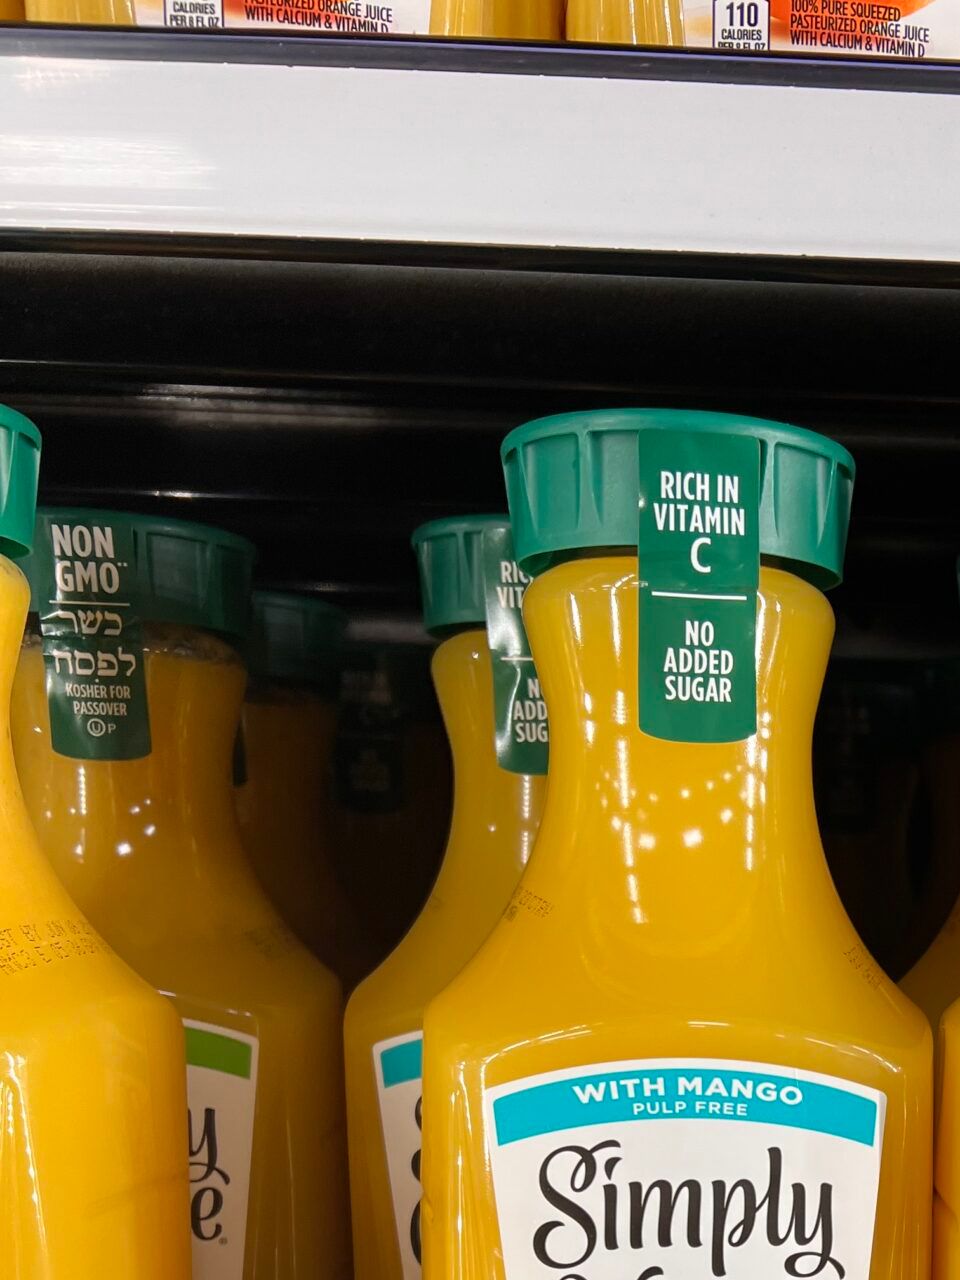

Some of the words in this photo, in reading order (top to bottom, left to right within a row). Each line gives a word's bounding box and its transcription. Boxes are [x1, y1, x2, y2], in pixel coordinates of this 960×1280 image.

[172, 2, 215, 15] CALORIES
[245, 6, 274, 22] WITH
[276, 10, 321, 28] CALCIUM
[317, 0, 362, 17] ORANGE
[364, 6, 393, 22] JUICE
[726, 2, 758, 27] 110
[821, 0, 848, 16] PURE
[850, 2, 900, 22] SQUEEZED
[721, 29, 762, 41] CALORIES
[790, 14, 857, 32] PASTEURIZED
[859, 20, 900, 37] ORANGE
[902, 26, 929, 43] JUICE
[790, 30, 817, 46] WITH
[819, 33, 862, 49] CALCIUM
[875, 39, 915, 57] VITAMIN
[660, 471, 709, 501] RICH
[717, 475, 739, 503] IN
[653, 503, 745, 536] VITAMIN
[51, 524, 115, 559] NON
[690, 537, 712, 573] C
[56, 561, 120, 594] GMO
[685, 620, 715, 647] NO
[663, 648, 733, 675] ADDED
[66, 683, 107, 699] KOSHER
[109, 683, 131, 699] FOR
[665, 676, 732, 703] SUGAR
[73, 701, 128, 716] PASSOVER
[572, 1077, 666, 1105] WITH
[677, 1076, 804, 1106] MANGO
[633, 1102, 693, 1116] PULP
[695, 1101, 749, 1117] FREE
[532, 1139, 846, 1280] Simply
